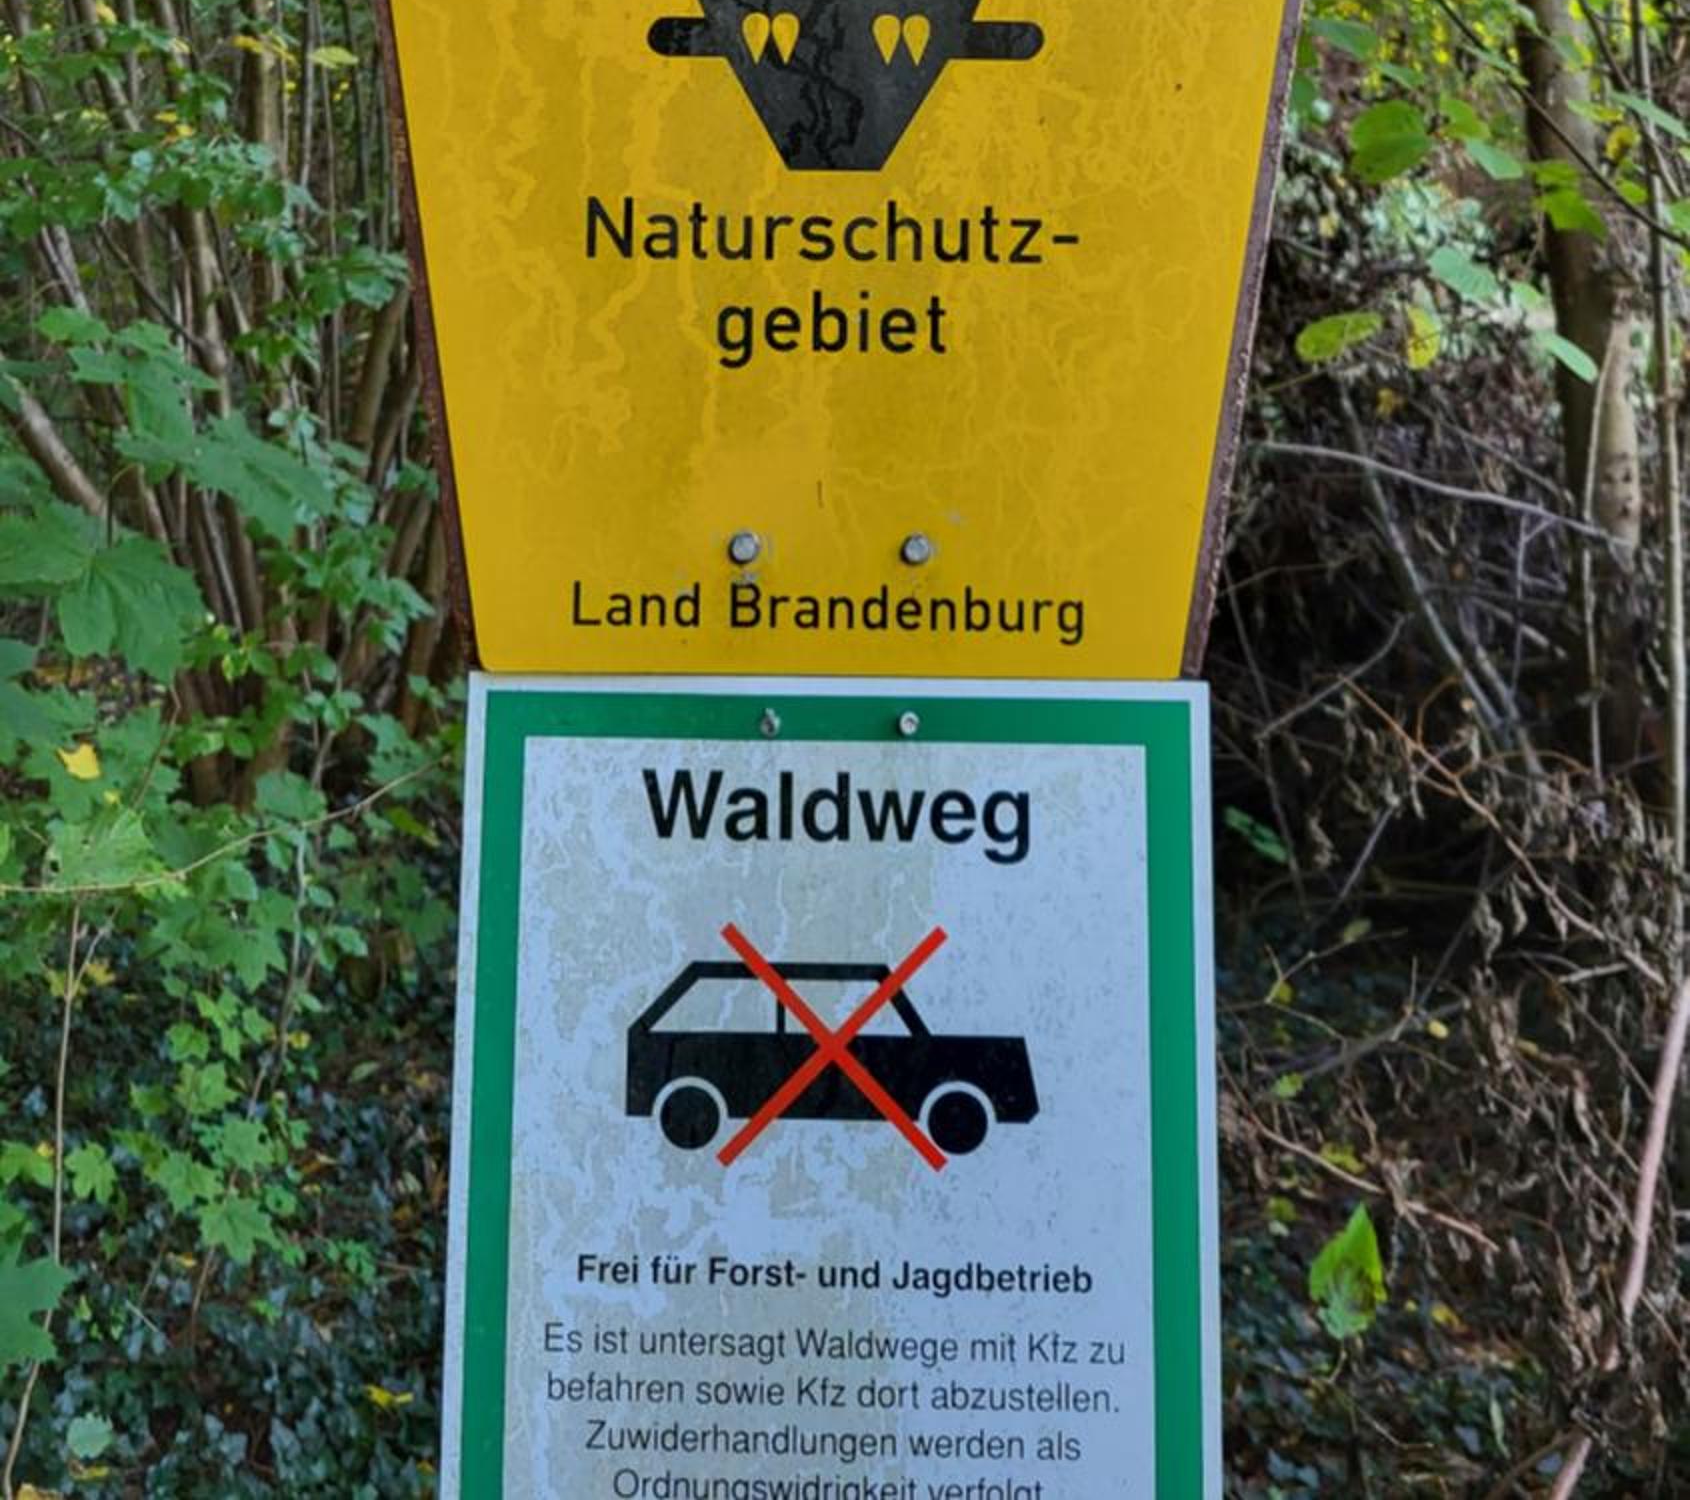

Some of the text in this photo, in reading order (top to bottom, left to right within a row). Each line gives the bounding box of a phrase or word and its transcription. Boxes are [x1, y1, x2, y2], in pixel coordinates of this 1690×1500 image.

[587, 196, 1078, 263] Naturschutz-
[718, 290, 945, 368] gebiet
[573, 581, 1083, 645] Land Brandenburg
[643, 769, 1029, 864] Waldweg
[578, 1254, 1092, 1298] Frei für Forst- und Jagdbetrieb
[544, 1322, 1124, 1368] Es ist untersagt Waldwege mit Kfz zu
[548, 1371, 1120, 1412] befahren sowie Kfz dort abzustellen.
[586, 1420, 1080, 1464] Zuwiderhandlungen werden als
